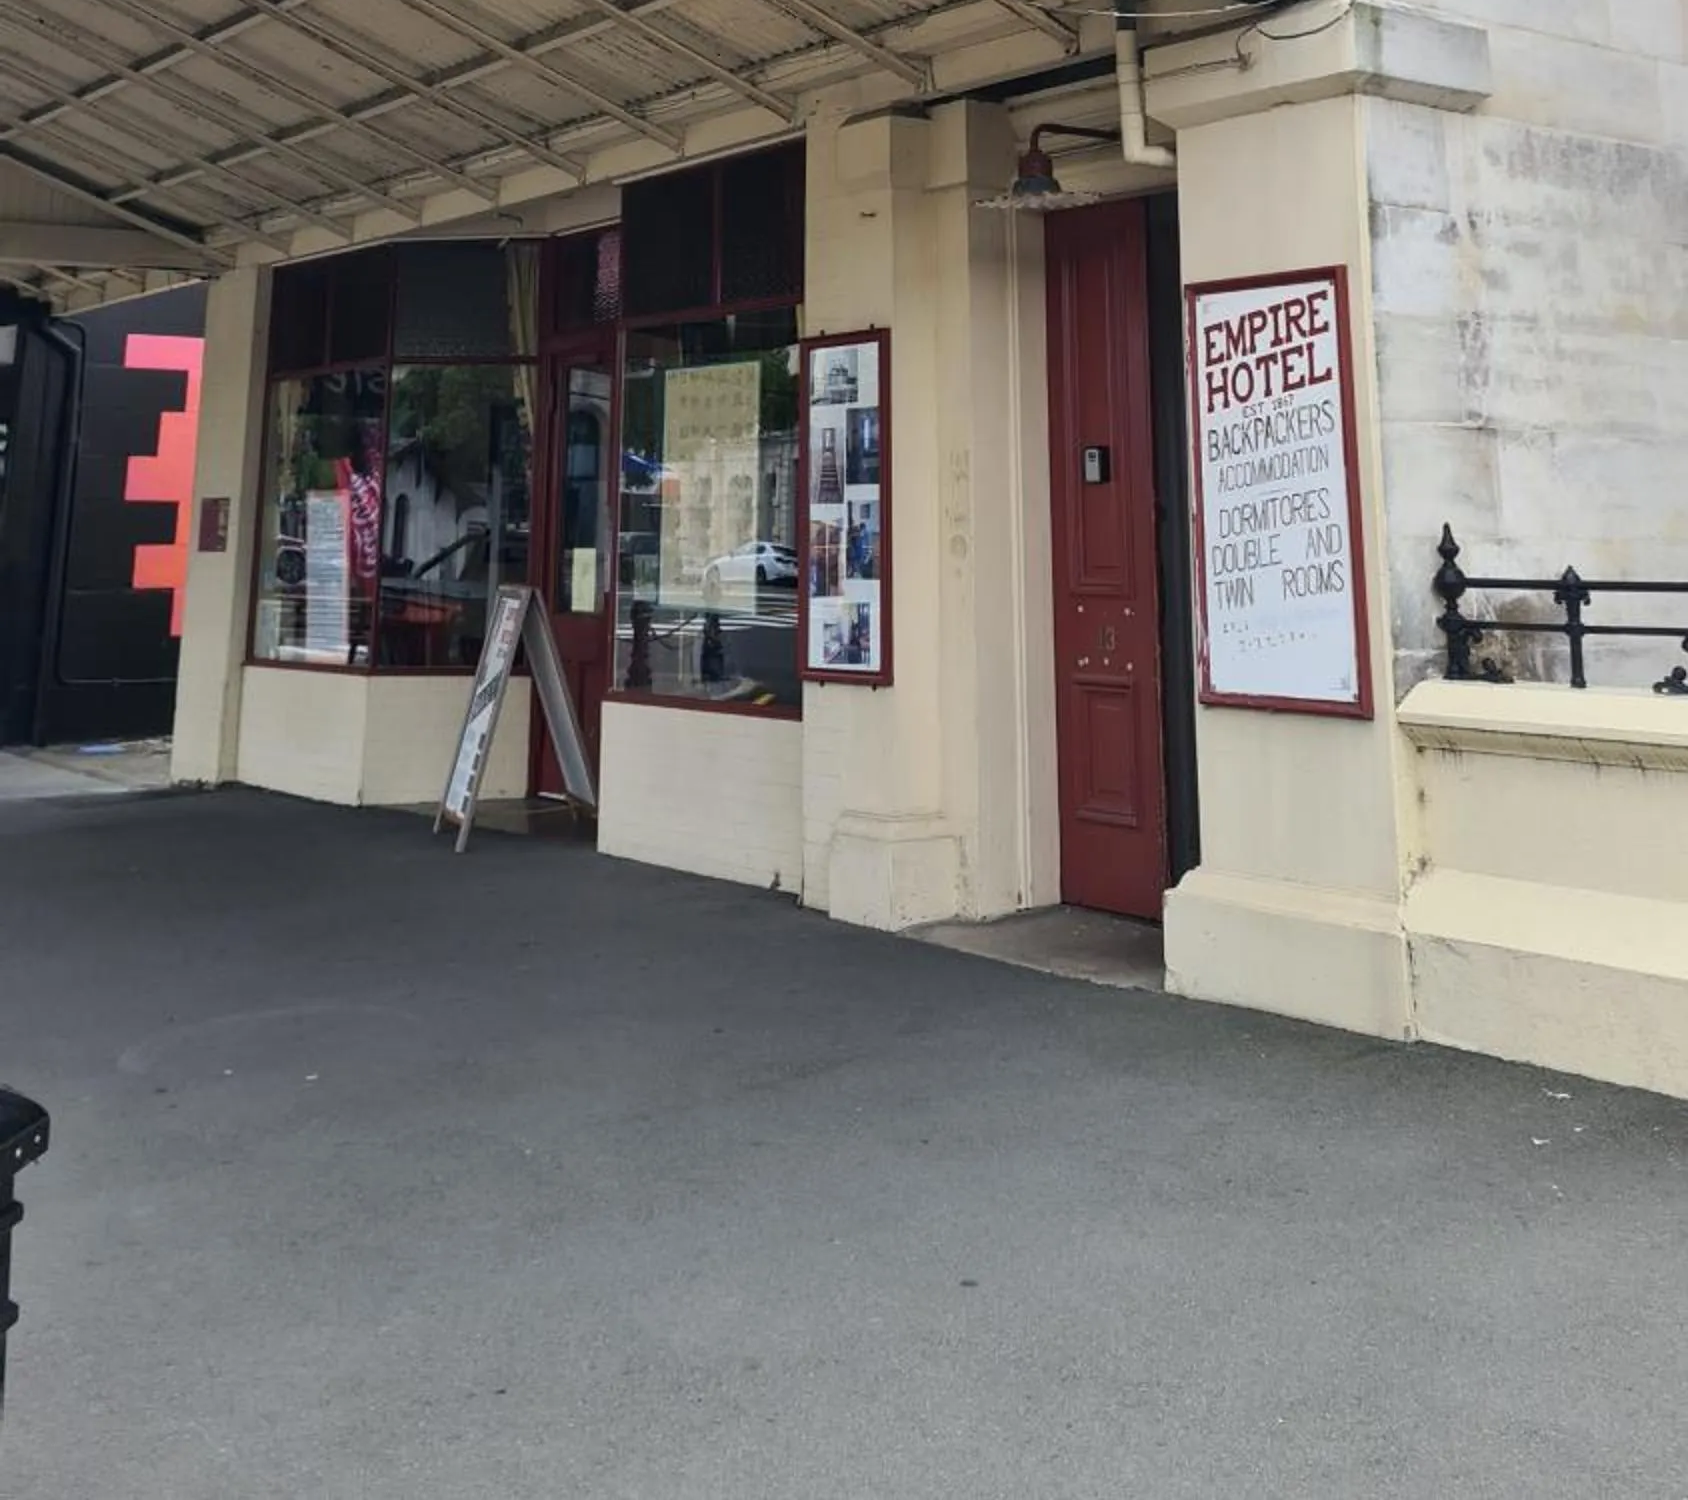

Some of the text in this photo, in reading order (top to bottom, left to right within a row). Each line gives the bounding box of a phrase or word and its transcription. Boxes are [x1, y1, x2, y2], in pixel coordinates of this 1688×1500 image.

[1203, 290, 1329, 367] EMPIRE
[1206, 342, 1333, 413] HOTEL
[1207, 400, 1336, 462] BACKPACKERS
[1242, 402, 1265, 418] EST
[1217, 444, 1330, 493] ACCOMMODATION
[1218, 487, 1331, 539] DORMITORIES
[1212, 523, 1343, 577] DOUBLE AND
[1213, 559, 1345, 611] TWIN ROOMS
